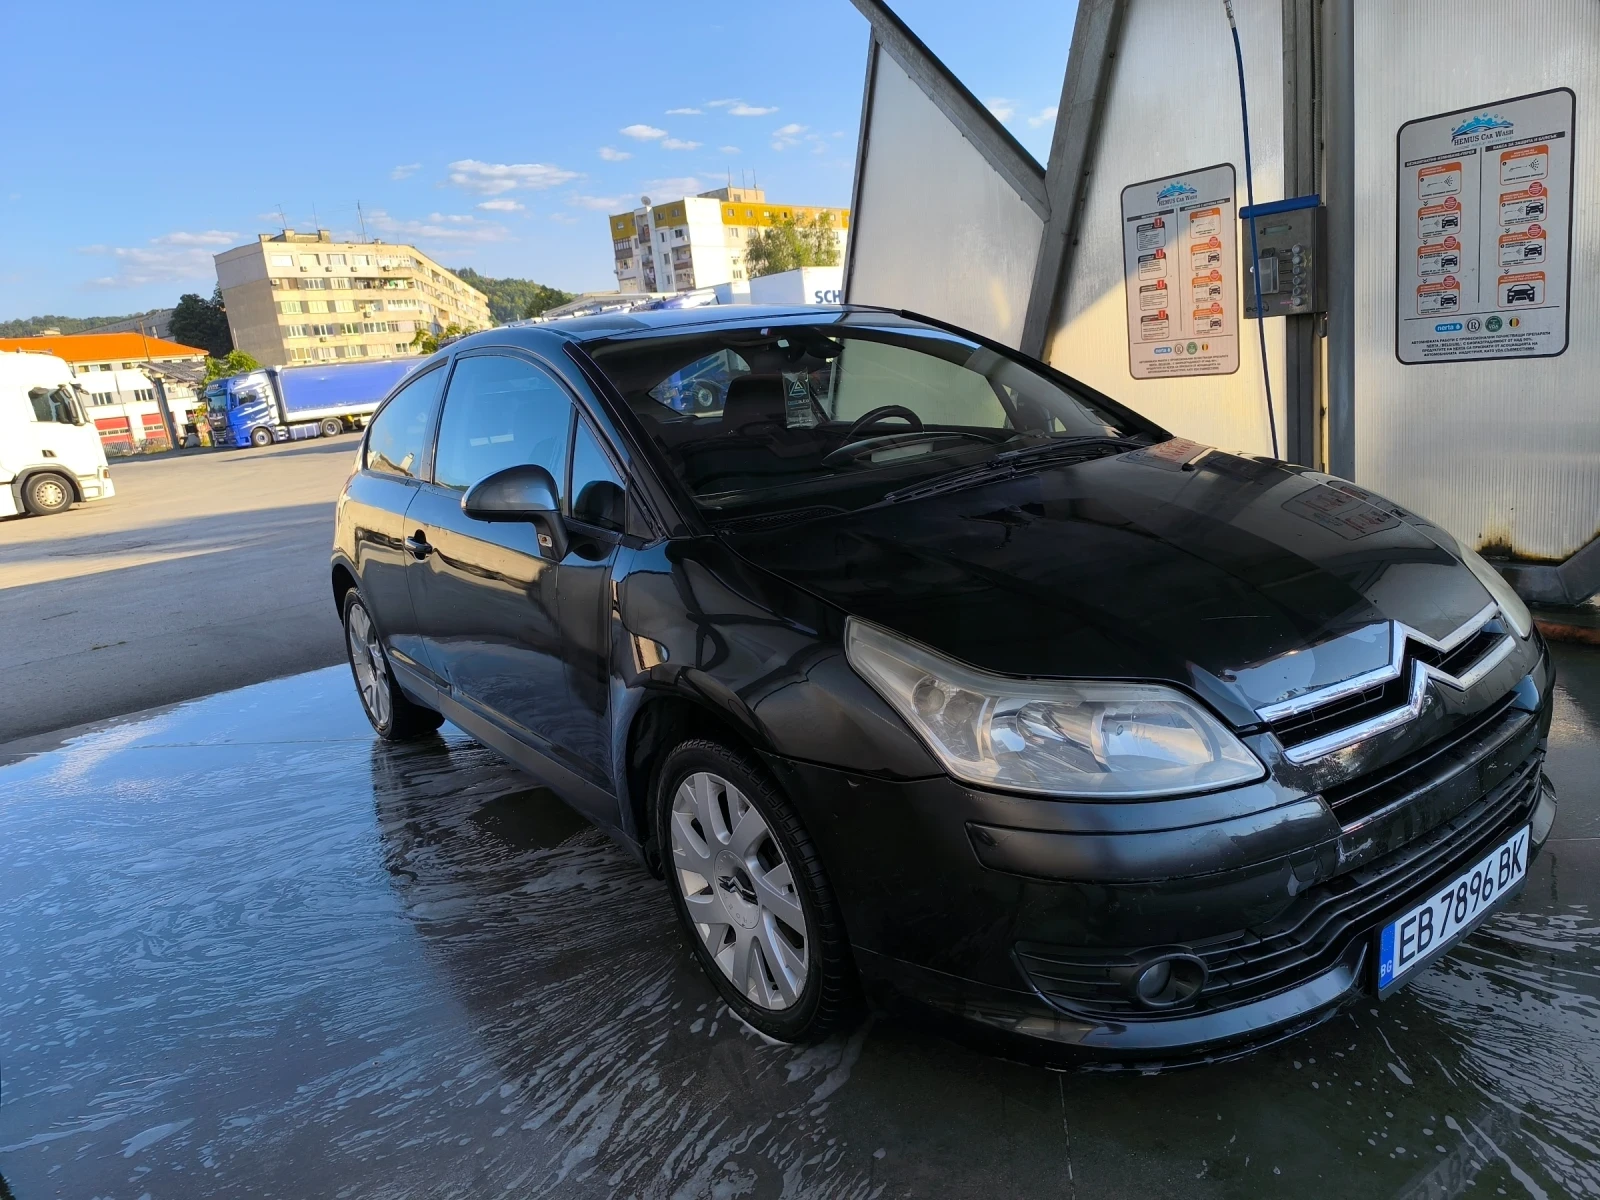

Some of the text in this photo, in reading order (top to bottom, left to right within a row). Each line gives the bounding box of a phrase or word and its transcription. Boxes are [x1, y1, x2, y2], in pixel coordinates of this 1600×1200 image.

[1398, 834, 1524, 967] EB 7896 BK
[1380, 959, 1392, 977] BG
